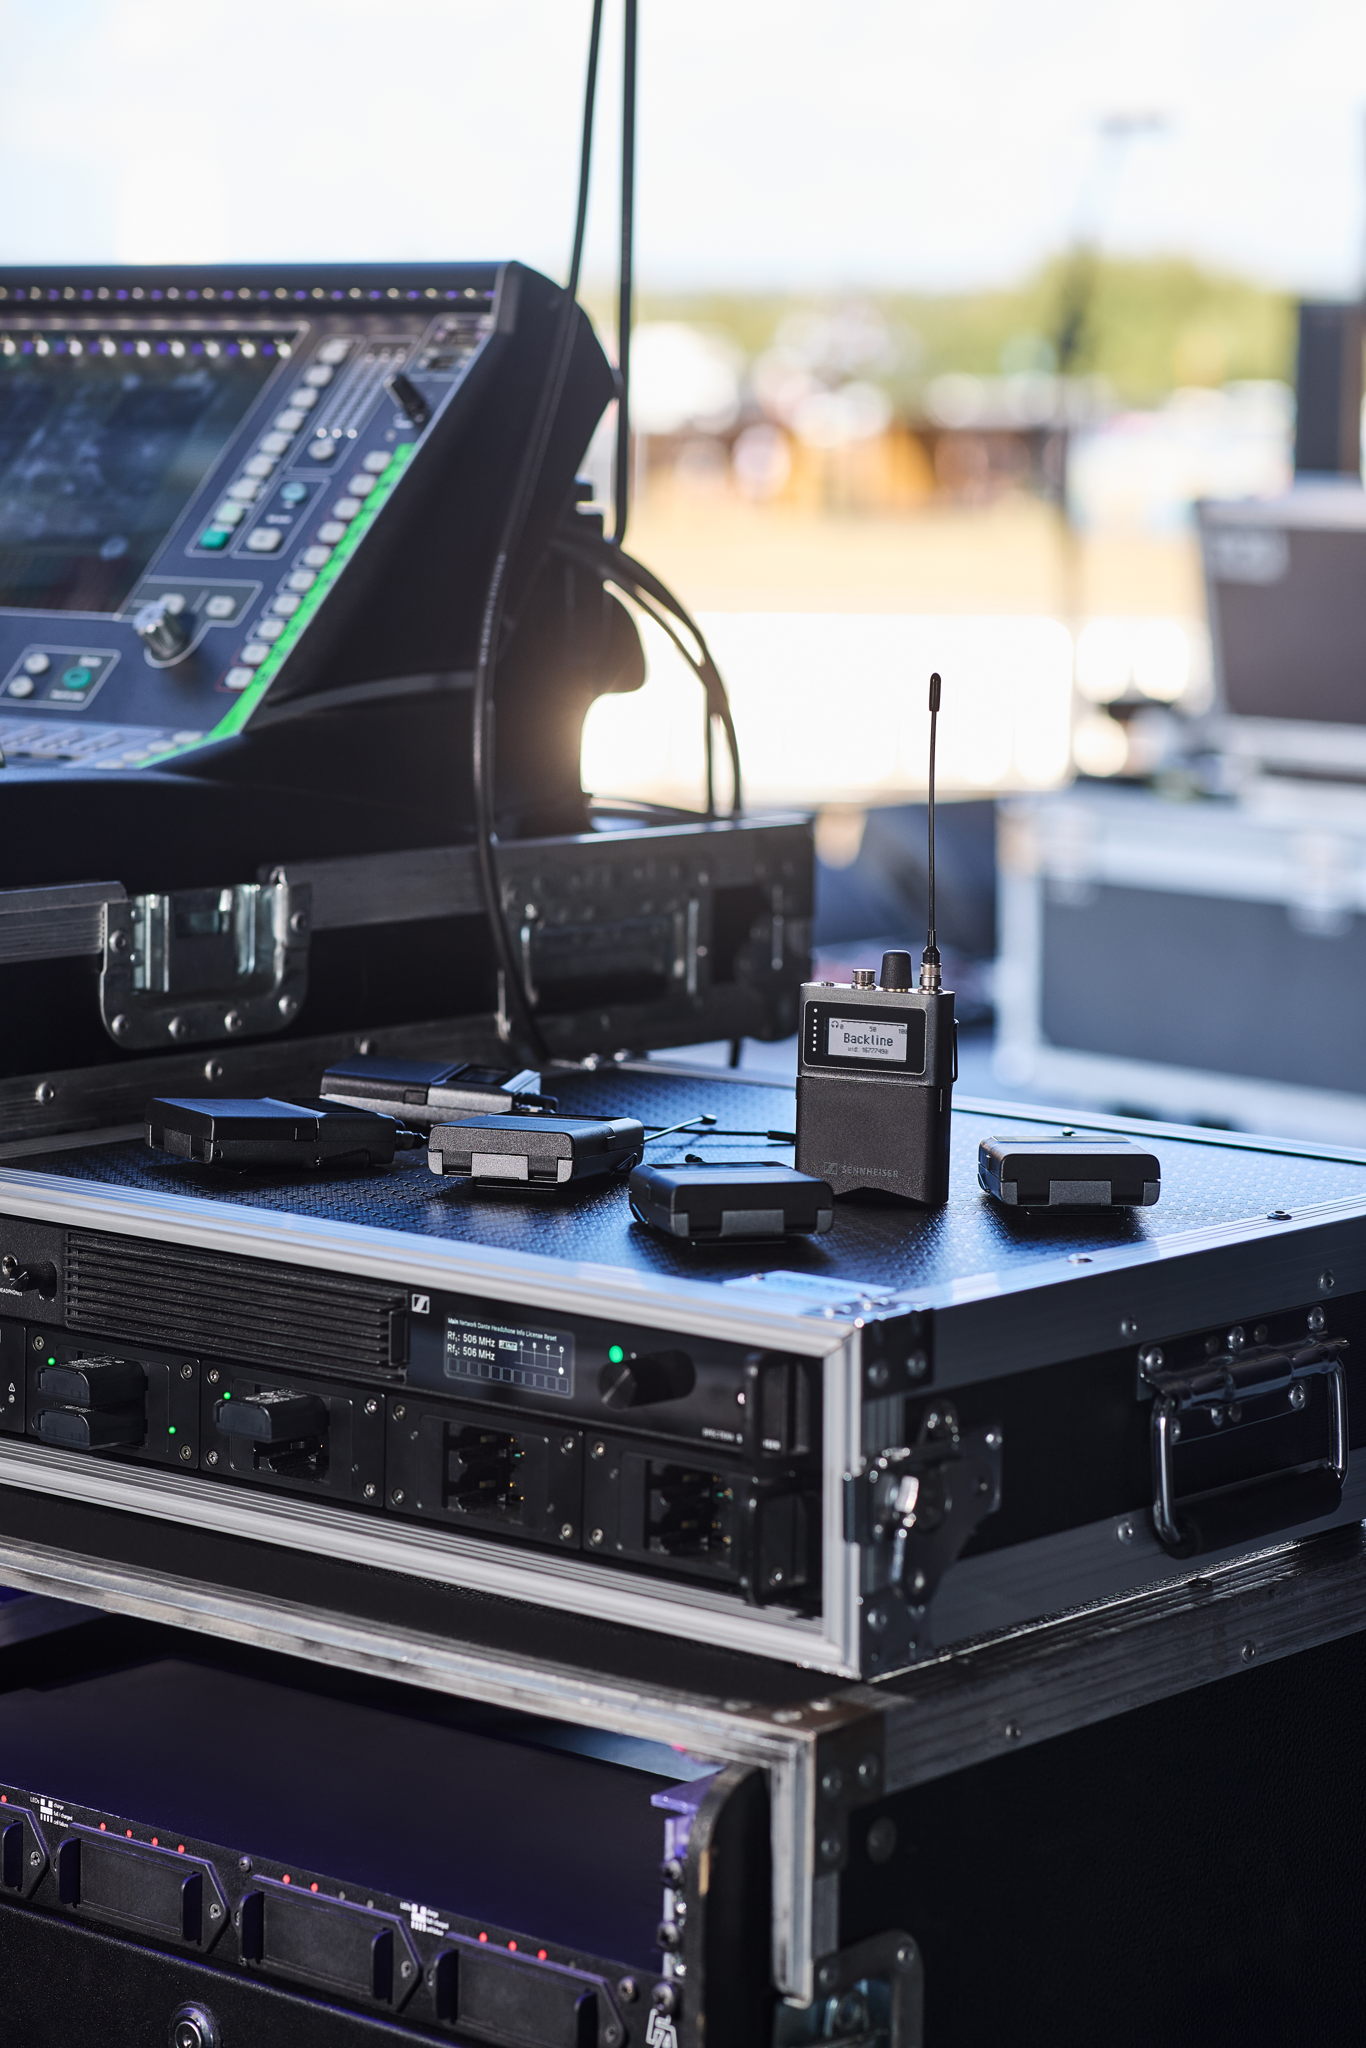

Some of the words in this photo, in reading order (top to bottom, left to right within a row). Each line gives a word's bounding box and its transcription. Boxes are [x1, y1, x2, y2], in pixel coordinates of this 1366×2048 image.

[843, 1032, 894, 1047] Backline
[841, 1165, 899, 1178] SENNHEISER
[463, 1333, 477, 1344] 506
[478, 1336, 495, 1348] MHz
[463, 1346, 477, 1357] 506
[478, 1349, 495, 1361] MHz
